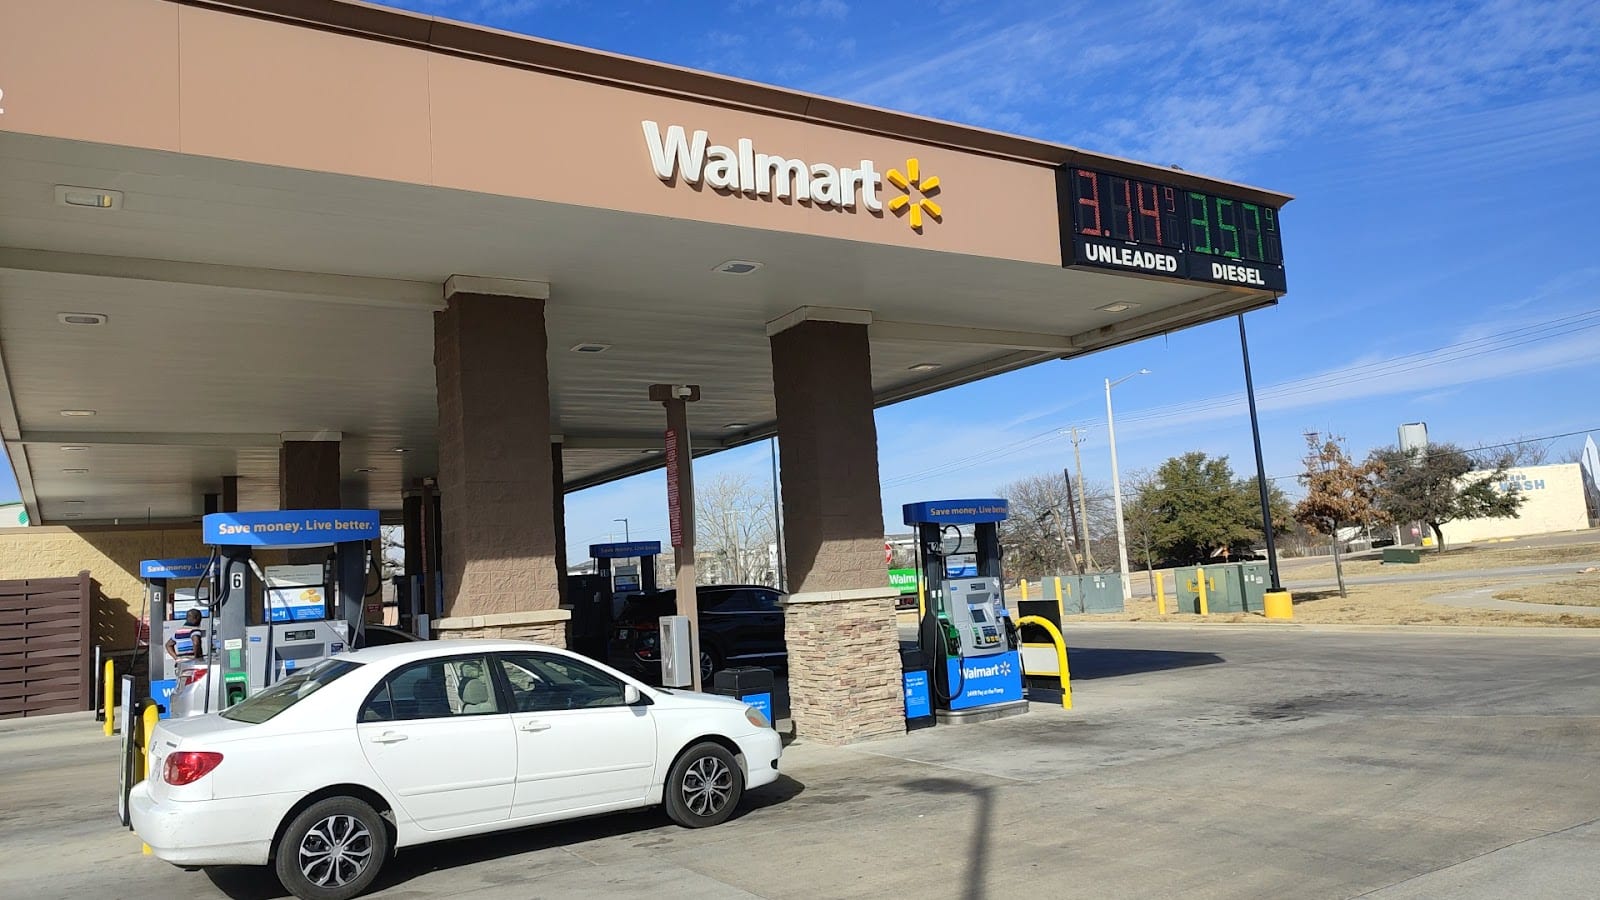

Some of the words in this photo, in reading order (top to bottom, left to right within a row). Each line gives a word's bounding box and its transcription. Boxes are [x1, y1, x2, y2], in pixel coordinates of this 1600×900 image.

[641, 120, 883, 212] Walmart
[1085, 243, 1178, 273] UNLEADED
[1212, 262, 1265, 286] DIESEL
[930, 507, 950, 516] Save
[951, 506, 978, 515] money.
[979, 505, 991, 513] Live
[218, 523, 250, 535] Save
[253, 522, 303, 533] money.
[305, 520, 332, 530] Live
[334, 519, 373, 530] better.
[233, 573, 241, 588] 6
[889, 574, 917, 585] Walm
[959, 664, 998, 679] Walmart
